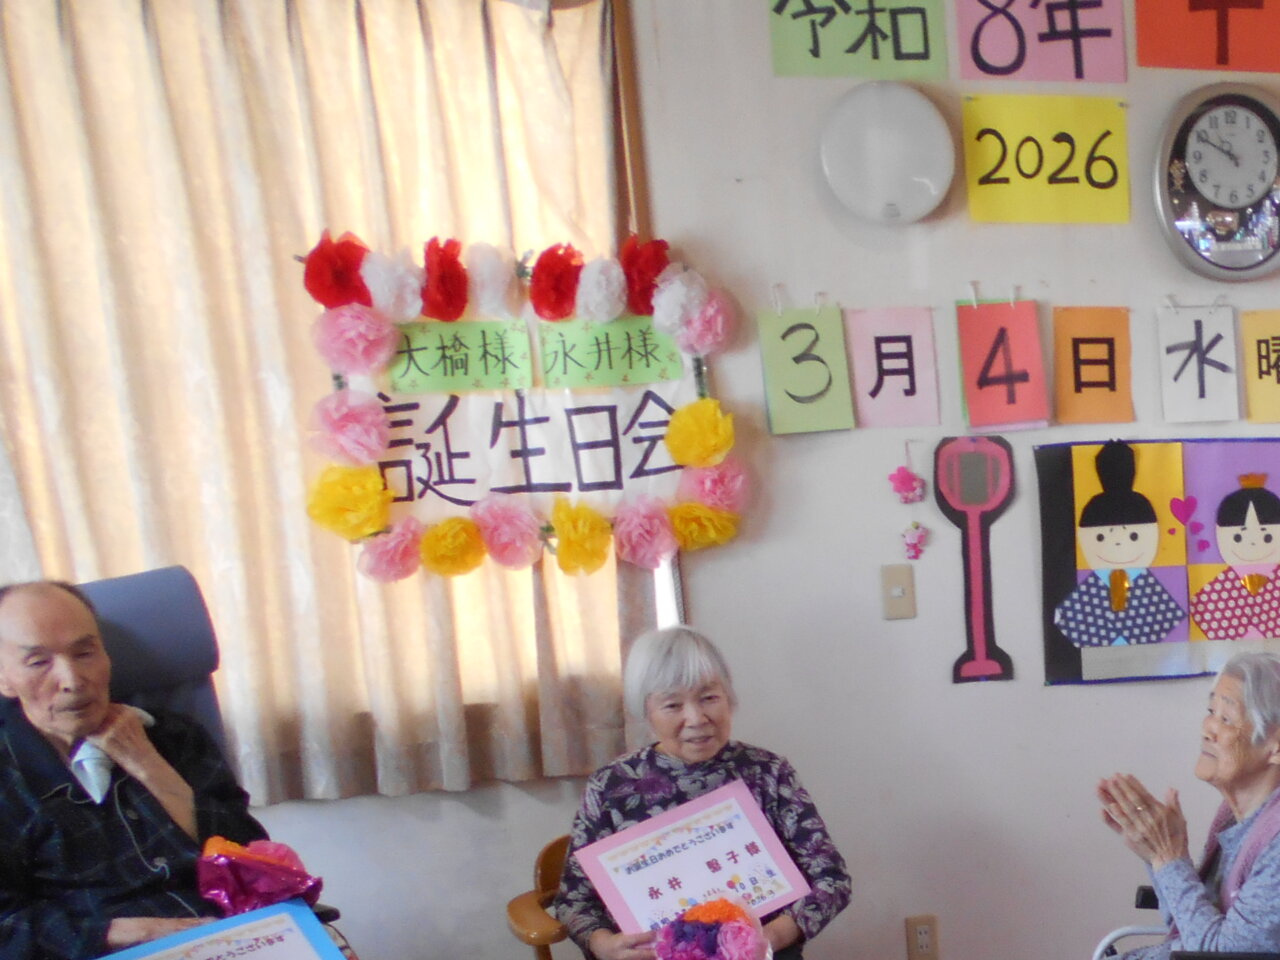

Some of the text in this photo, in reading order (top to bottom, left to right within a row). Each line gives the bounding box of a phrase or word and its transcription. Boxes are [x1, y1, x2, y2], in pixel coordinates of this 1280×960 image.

[772, 0, 930, 60] 令和
[1208, 115, 1219, 129] 11
[1224, 110, 1237, 125] 12
[976, 128, 1120, 189] 2026
[1212, 184, 1221, 199] 7
[1229, 190, 1239, 203] 6
[398, 329, 520, 379] 大橋様
[544, 327, 661, 375] 永井様
[780, 322, 832, 405] 3
[868, 335, 917, 398] 月
[976, 327, 1030, 405] 4
[1071, 336, 1117, 394] 日
[1166, 320, 1234, 399] 水
[377, 389, 684, 506] 誕生日会
